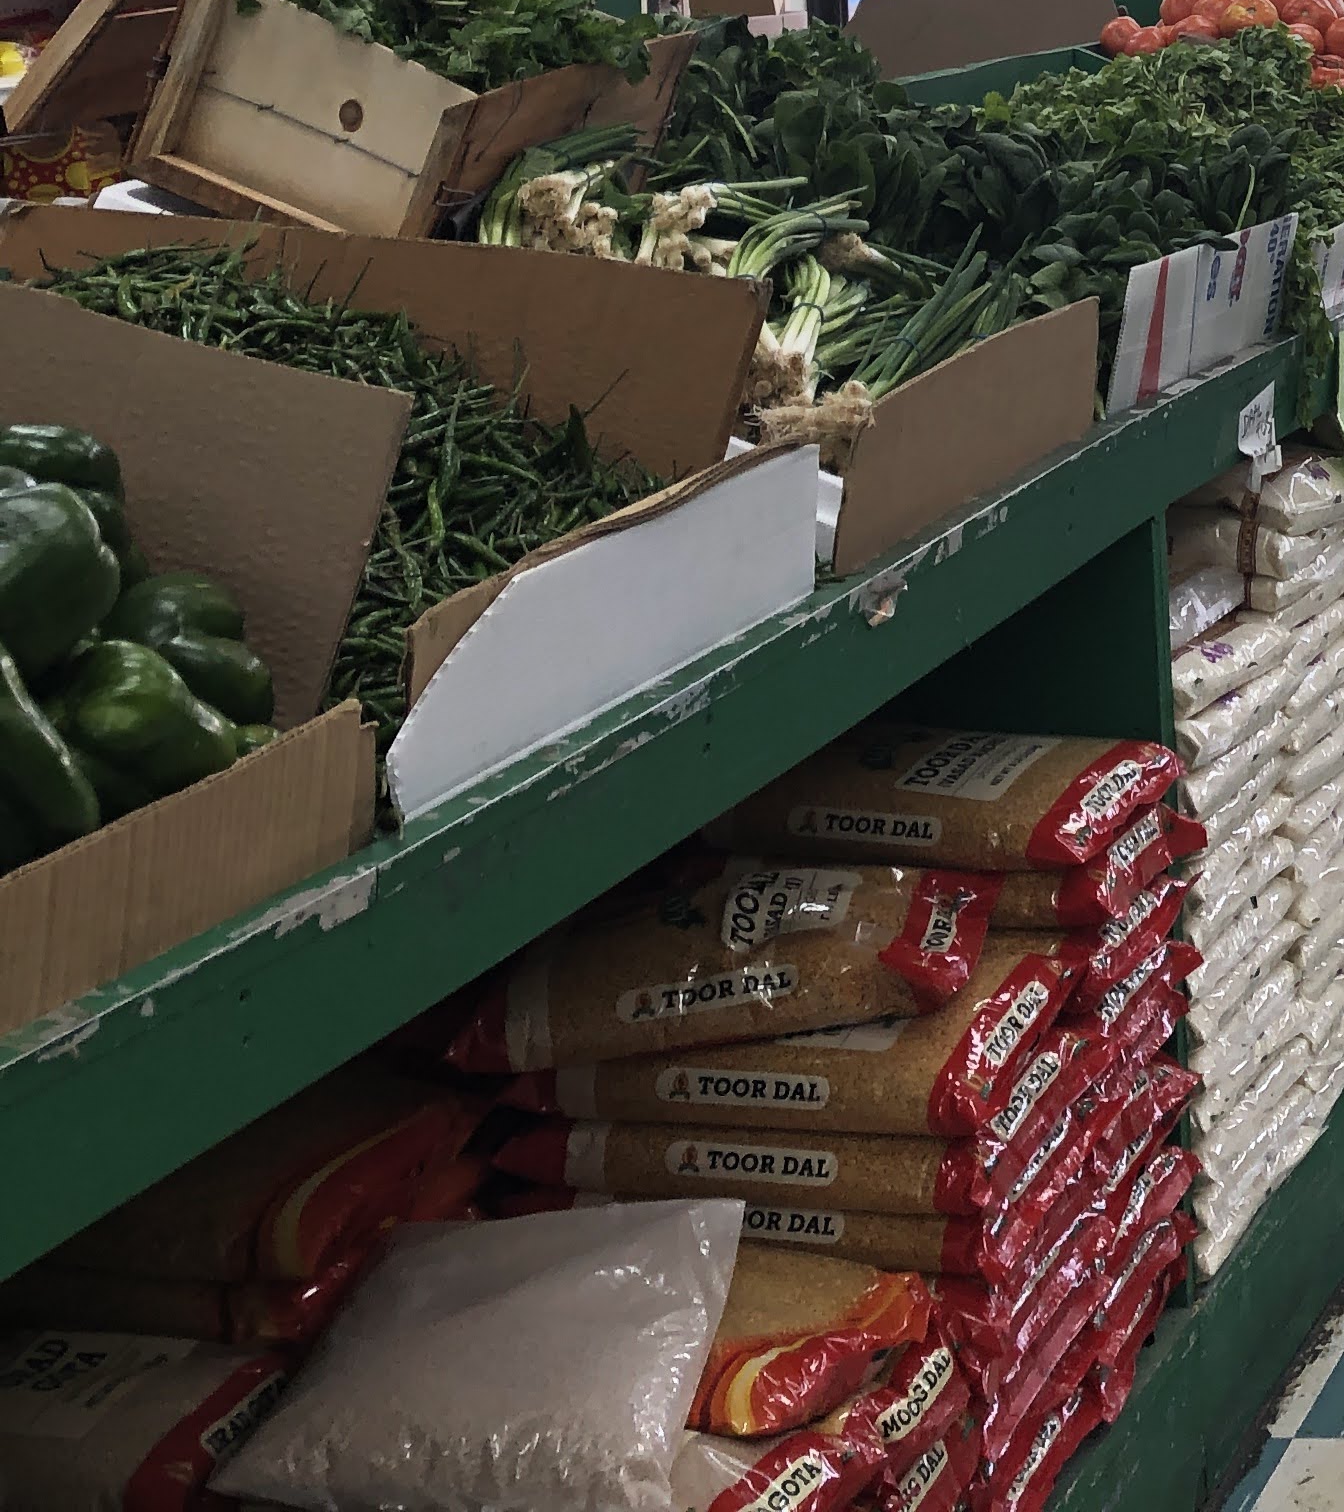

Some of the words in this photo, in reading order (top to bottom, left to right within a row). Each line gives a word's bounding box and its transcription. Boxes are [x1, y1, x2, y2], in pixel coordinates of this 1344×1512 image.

[905, 746, 960, 789] TOOR
[824, 813, 889, 835] TOOR
[892, 817, 934, 840] DAL
[661, 976, 736, 1011] TOOR
[743, 968, 793, 998] DAL
[699, 1075, 768, 1100] TOOR
[773, 1080, 821, 1102] DAL
[707, 1150, 775, 1174] TOOR
[782, 1156, 830, 1179] DAL
[743, 1209, 782, 1232] OR
[787, 1213, 836, 1238] DAL
[882, 1384, 928, 1440] MOOG
[924, 1352, 953, 1389] DAL
[918, 1445, 945, 1483] DAL
[755, 1460, 823, 1512] GOTA
